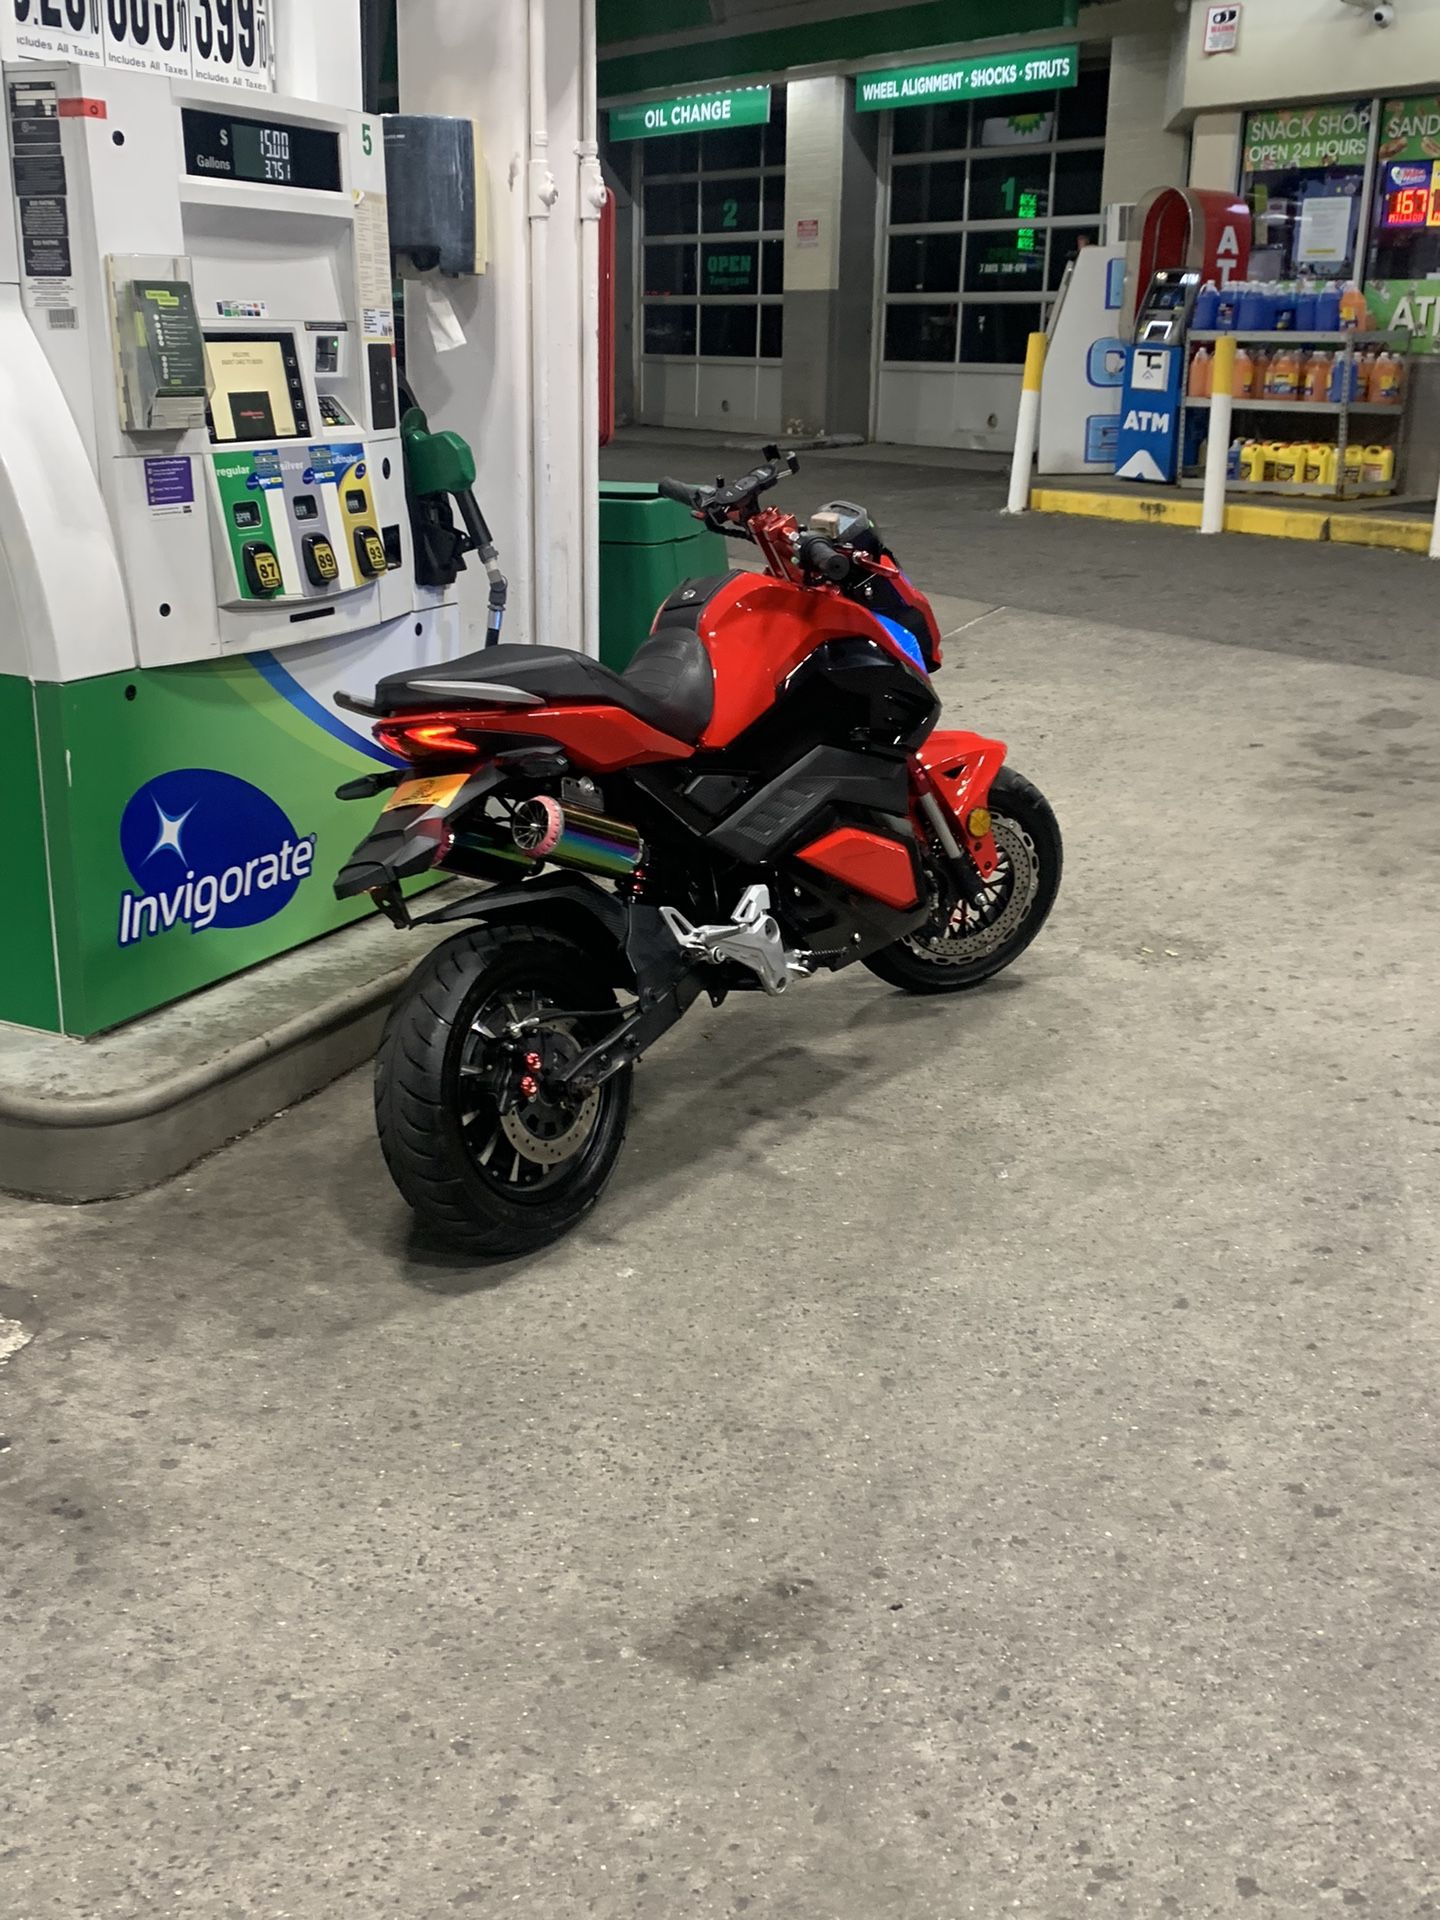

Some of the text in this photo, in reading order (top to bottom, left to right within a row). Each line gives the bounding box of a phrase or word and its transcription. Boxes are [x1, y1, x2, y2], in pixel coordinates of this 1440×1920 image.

[16, 36, 100, 59] cludes All Taxes
[108, 52, 189, 76] Includes All Taxes
[195, 69, 267, 91] Includes All Taxes
[862, 58, 1070, 101] WHEEL ALIGNMENT SHOCKS STRUTS
[644, 99, 732, 128] OIL CHANGE
[1252, 112, 1370, 142] SNACK SHOP
[361, 123, 373, 156] 5
[1249, 138, 1368, 162] OPEN 24 HOURS
[196, 154, 231, 171] Gallons
[1001, 177, 1016, 210] 1
[1396, 189, 1428, 215] 167
[723, 201, 738, 227] 2
[707, 255, 752, 273] OPEN
[1388, 296, 1440, 338] AT
[1123, 410, 1169, 433] ATM
[217, 465, 250, 478] regular
[280, 461, 303, 471] silver
[318, 554, 333, 569] 89
[369, 547, 383, 559] 93
[259, 563, 275, 579] 87
[120, 839, 314, 943] Invigorate
